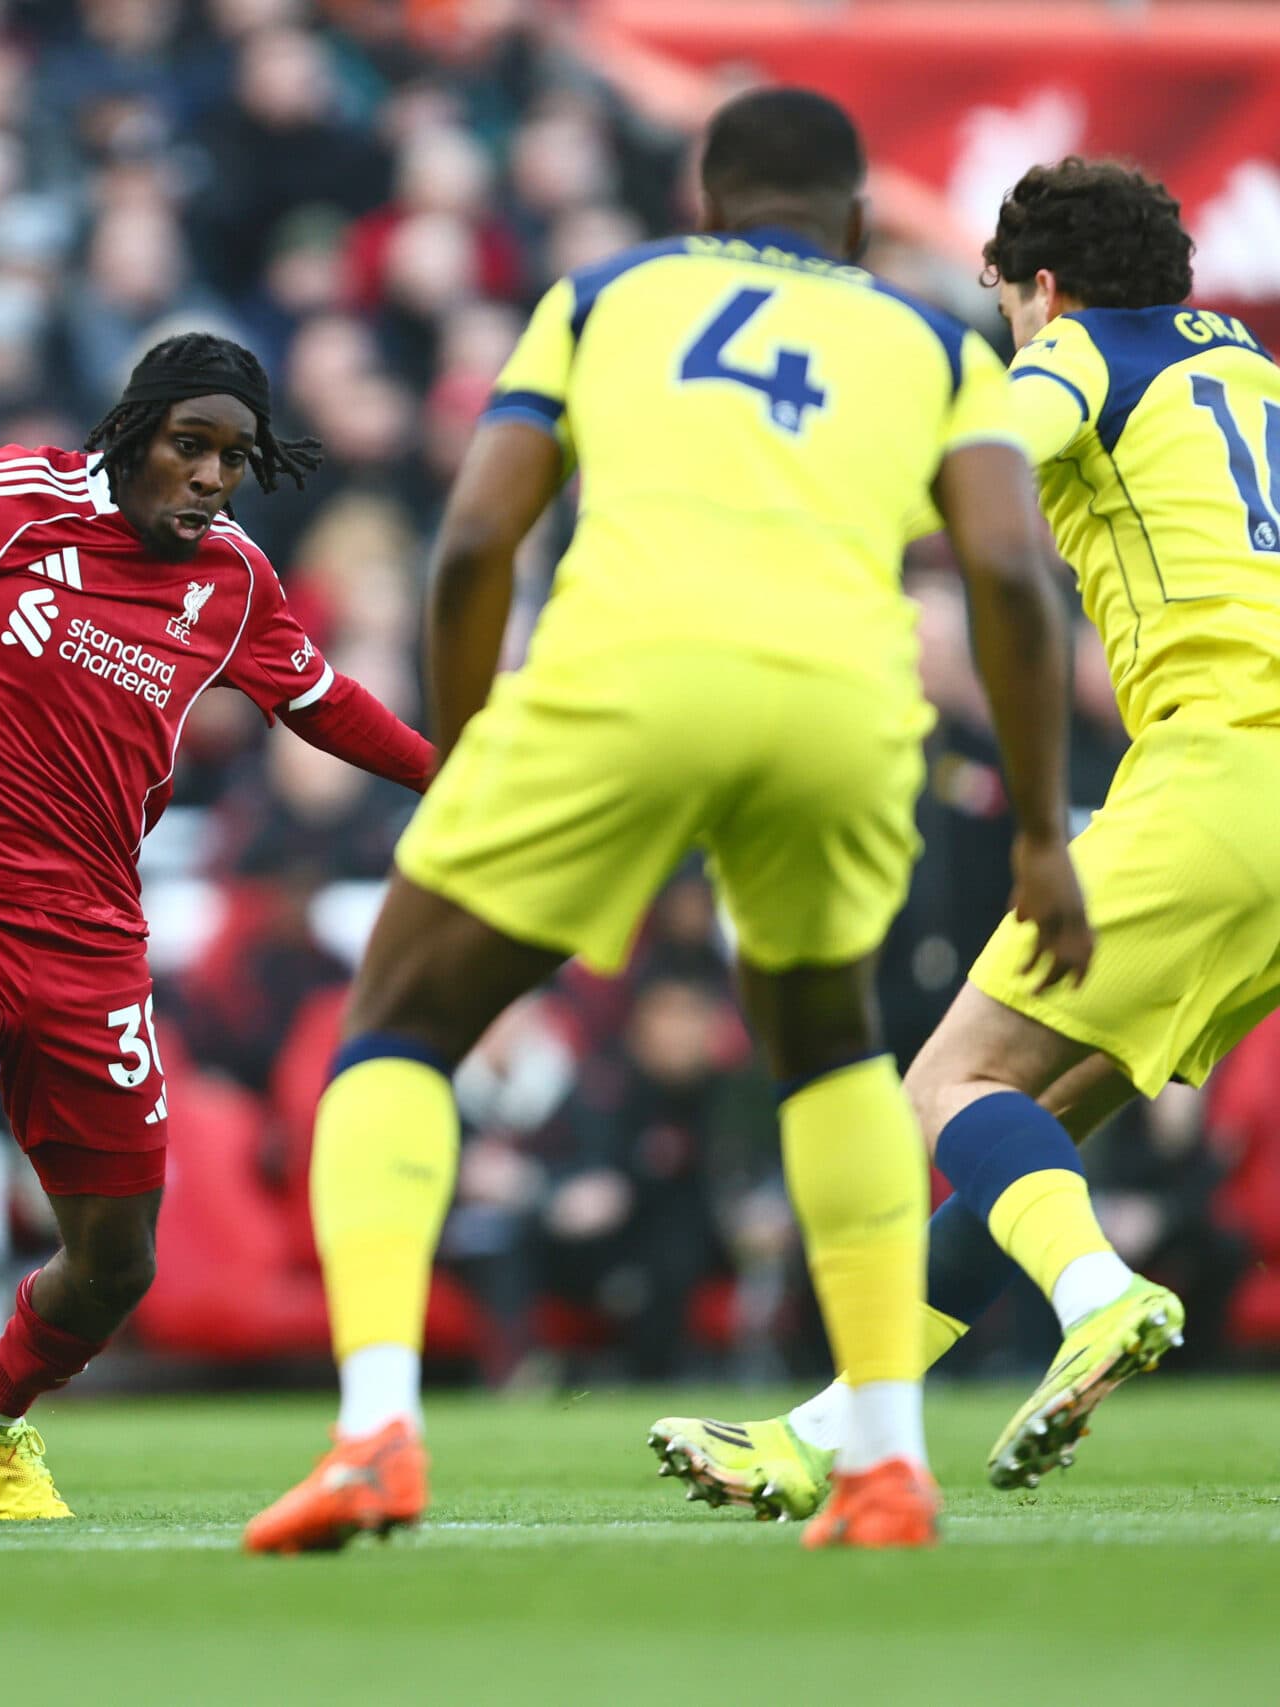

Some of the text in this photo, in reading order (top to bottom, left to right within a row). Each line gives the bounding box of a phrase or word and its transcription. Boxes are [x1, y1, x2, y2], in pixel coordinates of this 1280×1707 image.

[681, 289, 825, 433] 4
[59, 640, 172, 710] chartered
[67, 619, 177, 686] standard
